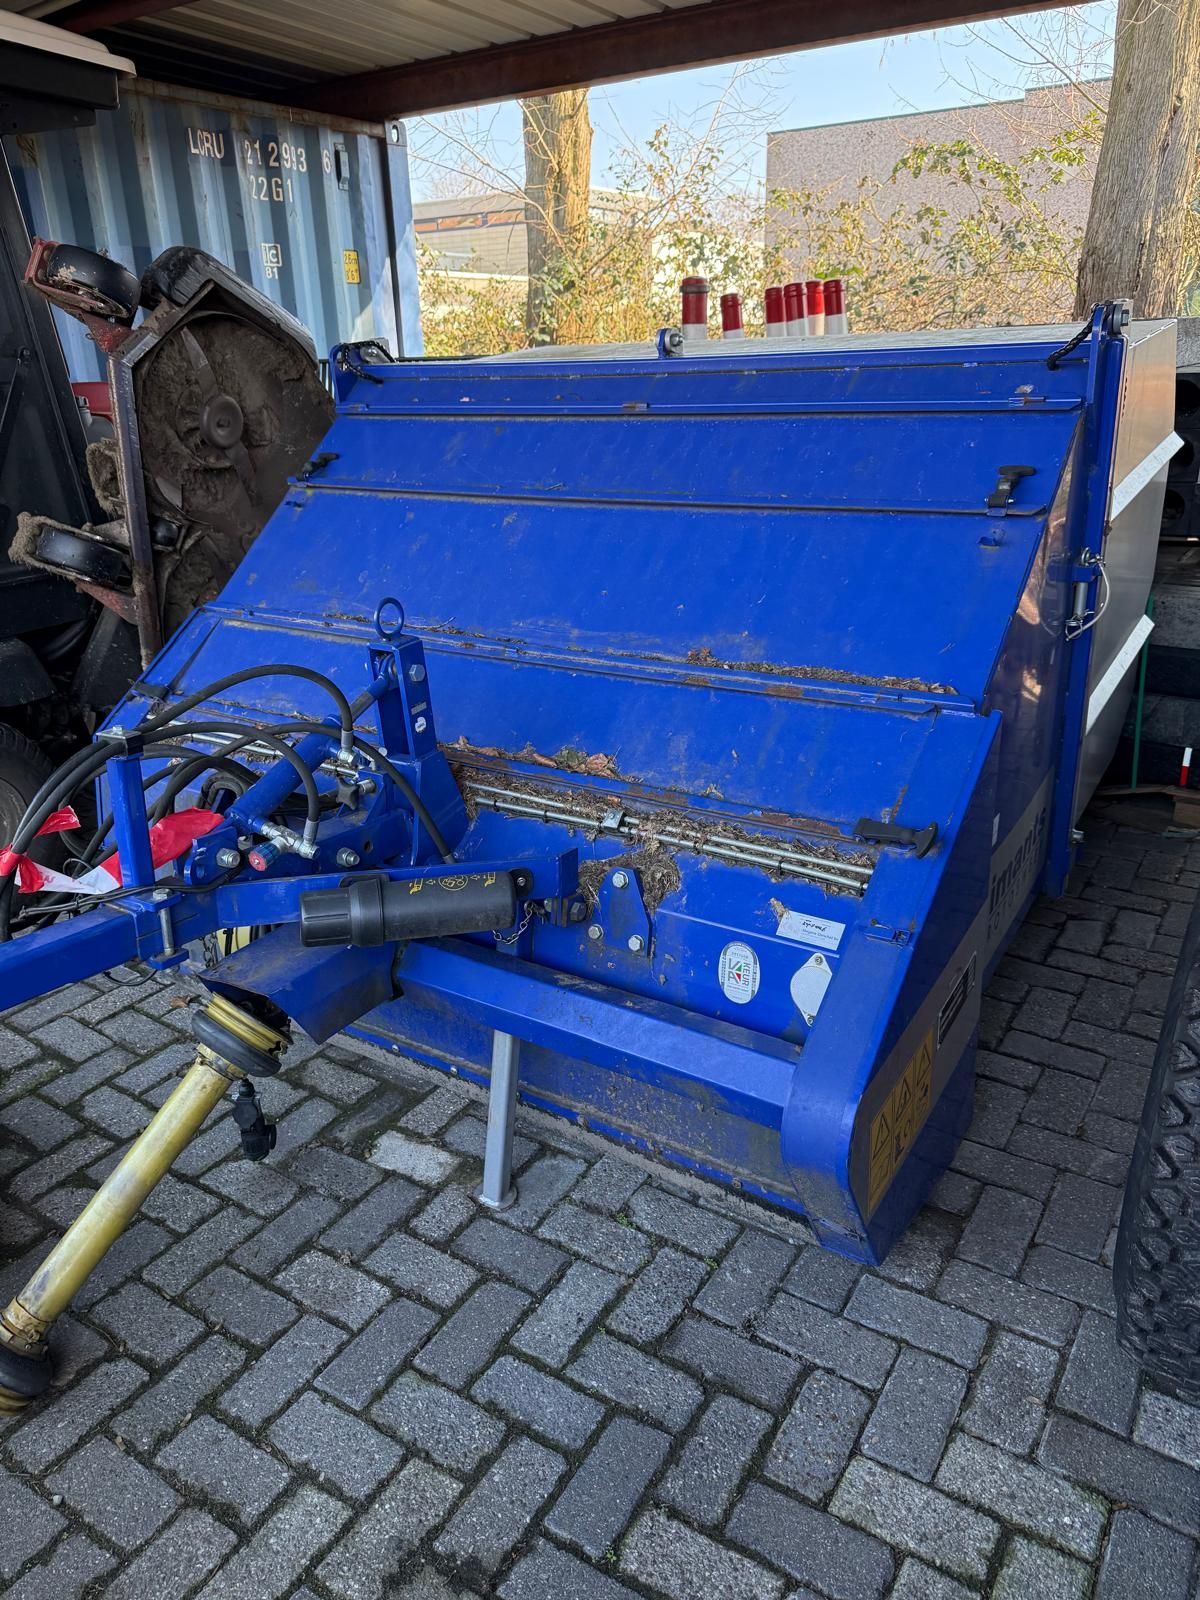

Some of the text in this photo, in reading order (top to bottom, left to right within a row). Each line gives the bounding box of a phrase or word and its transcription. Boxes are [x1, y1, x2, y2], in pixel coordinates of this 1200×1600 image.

[188, 128, 225, 159] LCRU
[322, 149, 332, 174] 6
[250, 175, 293, 203] 22G1
[742, 962, 752, 987] KEUR
